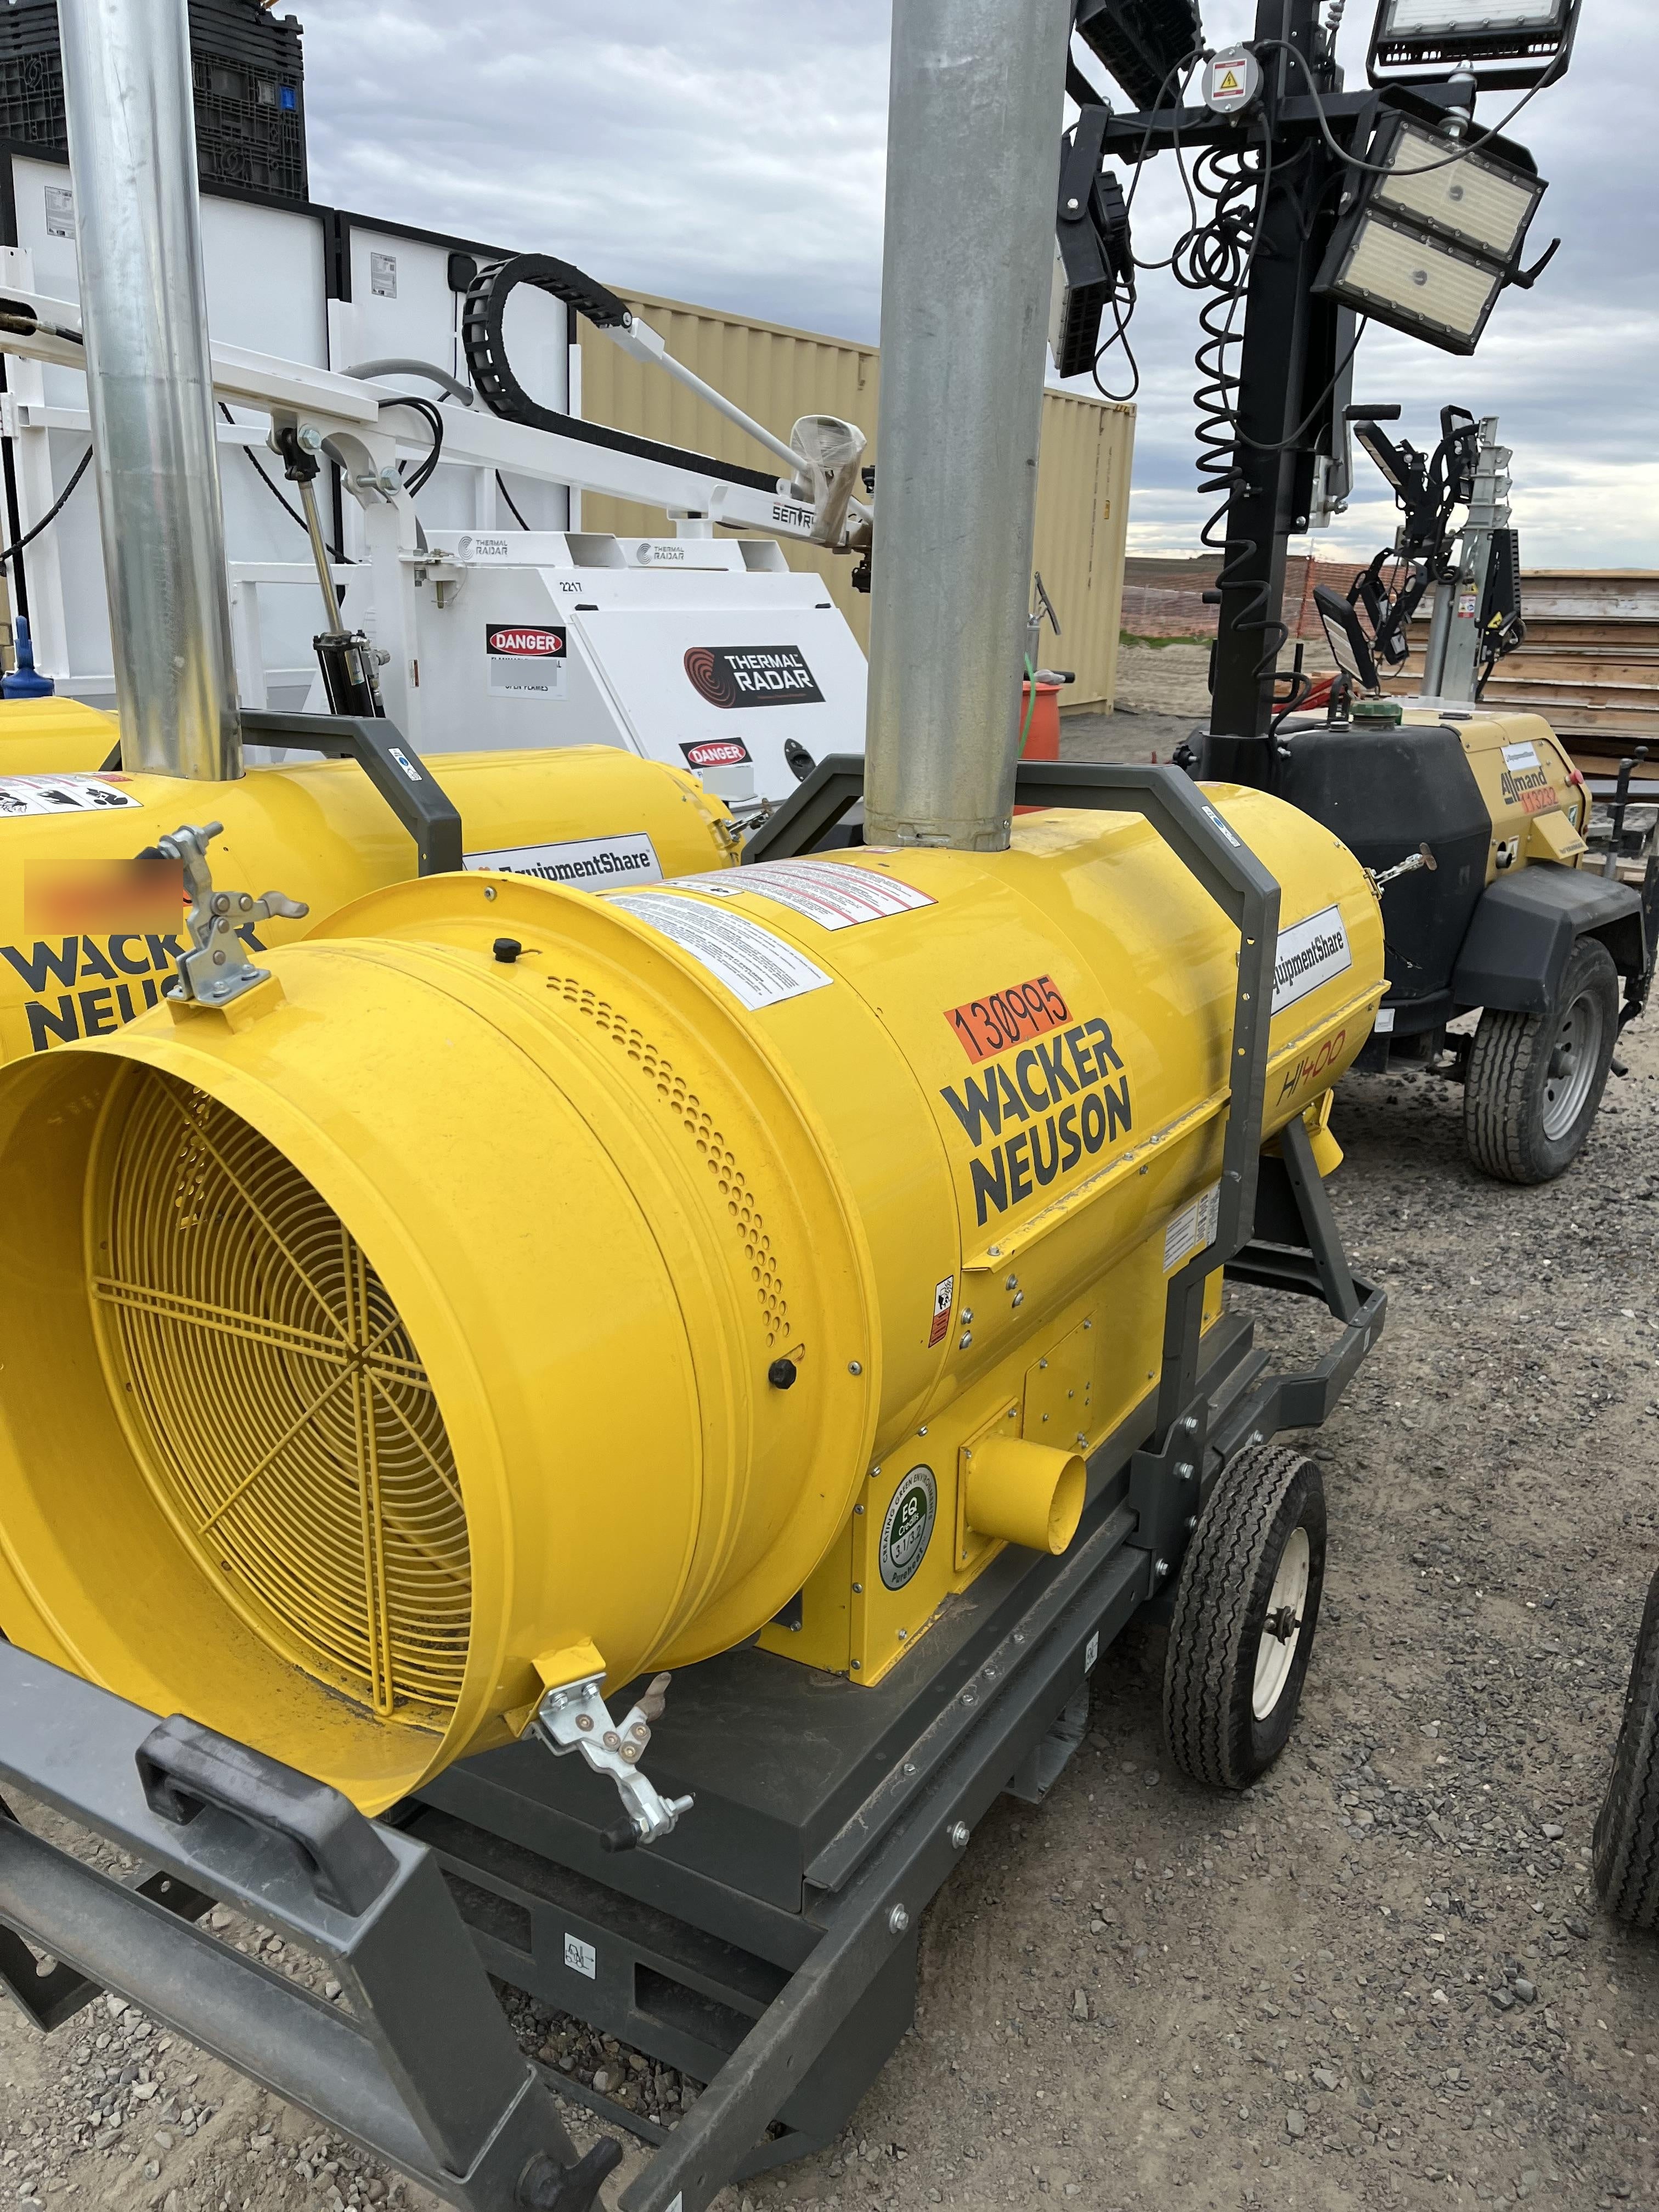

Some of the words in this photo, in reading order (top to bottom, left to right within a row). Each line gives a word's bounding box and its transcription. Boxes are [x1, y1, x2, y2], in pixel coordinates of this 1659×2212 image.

[476, 546, 508, 556] RADAR
[654, 552, 685, 560] RADAR
[560, 582, 582, 592] 2217
[495, 634, 556, 650] DANGER
[724, 653, 803, 669] THERMAL
[733, 670, 814, 691] RADAR
[691, 746, 743, 763] DANGER
[1500, 766, 1548, 802] Allmand
[955, 976, 1068, 1057] 130995
[1276, 1029, 1346, 1107] HI400
[939, 1018, 1124, 1148] WACKER
[969, 1074, 1132, 1228] NEUSON
[883, 1509, 895, 1563] CREATING
[895, 1477, 912, 1505] GREEN
[913, 1472, 934, 1521] ENVIRONMENTS
[902, 1497, 918, 1523] EQ
[899, 1513, 919, 1536] Credits
[895, 1525, 921, 1558] 3.1/3.2
